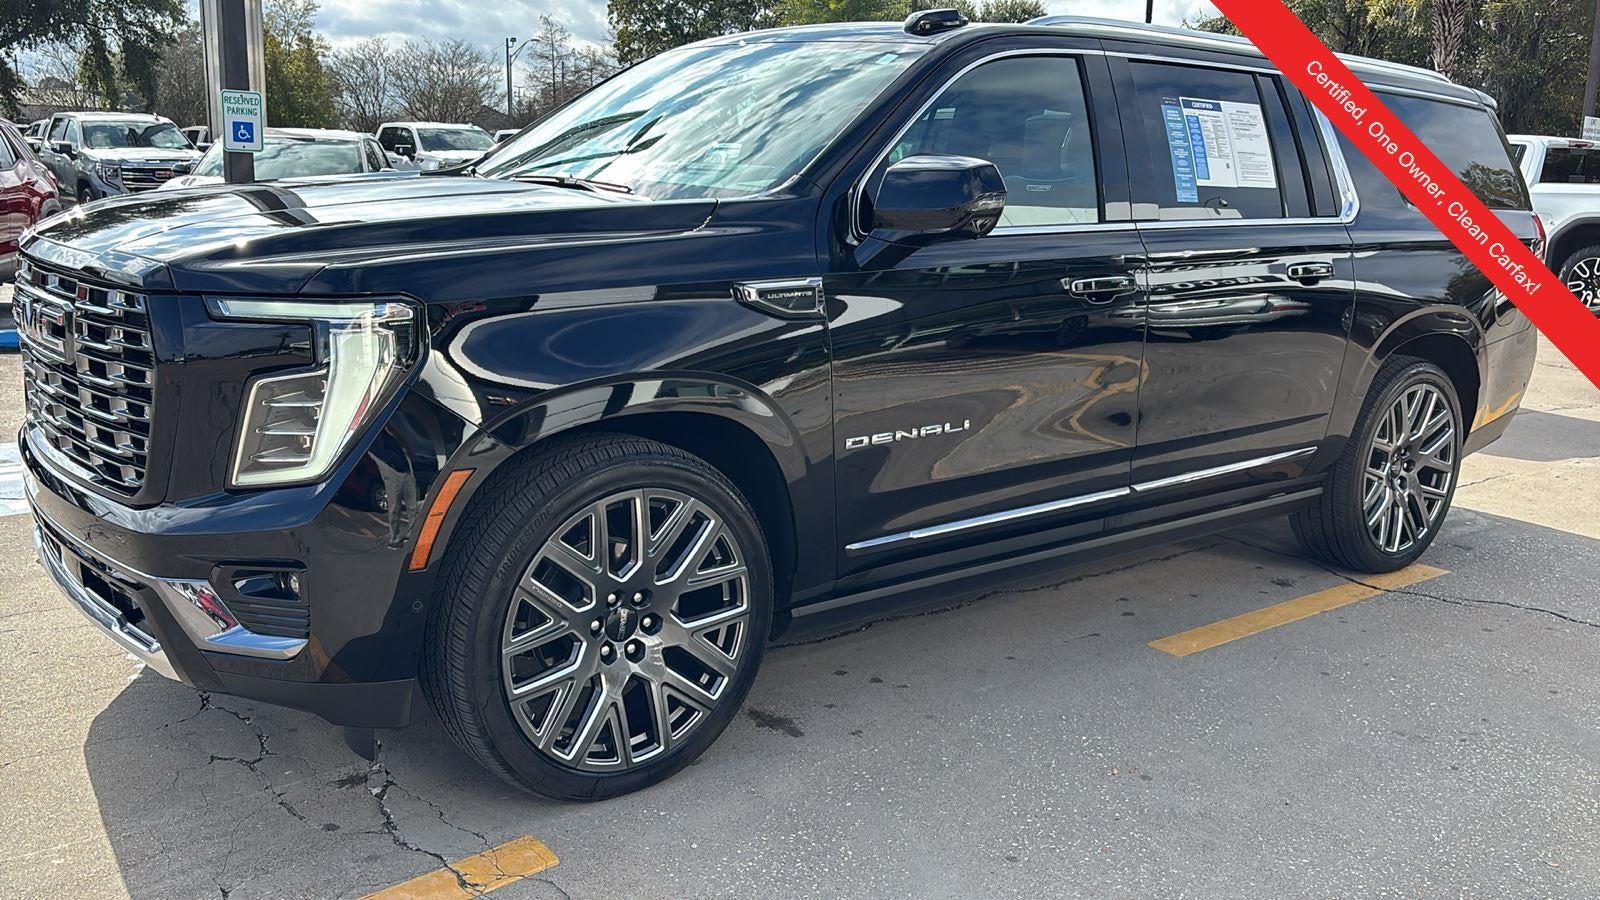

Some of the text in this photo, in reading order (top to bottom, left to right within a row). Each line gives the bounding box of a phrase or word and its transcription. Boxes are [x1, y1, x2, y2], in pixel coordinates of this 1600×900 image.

[223, 95, 260, 106] RESERVED
[226, 106, 258, 116] PARKING
[767, 291, 813, 299] ULTIMATE
[845, 419, 970, 450] DENALI
